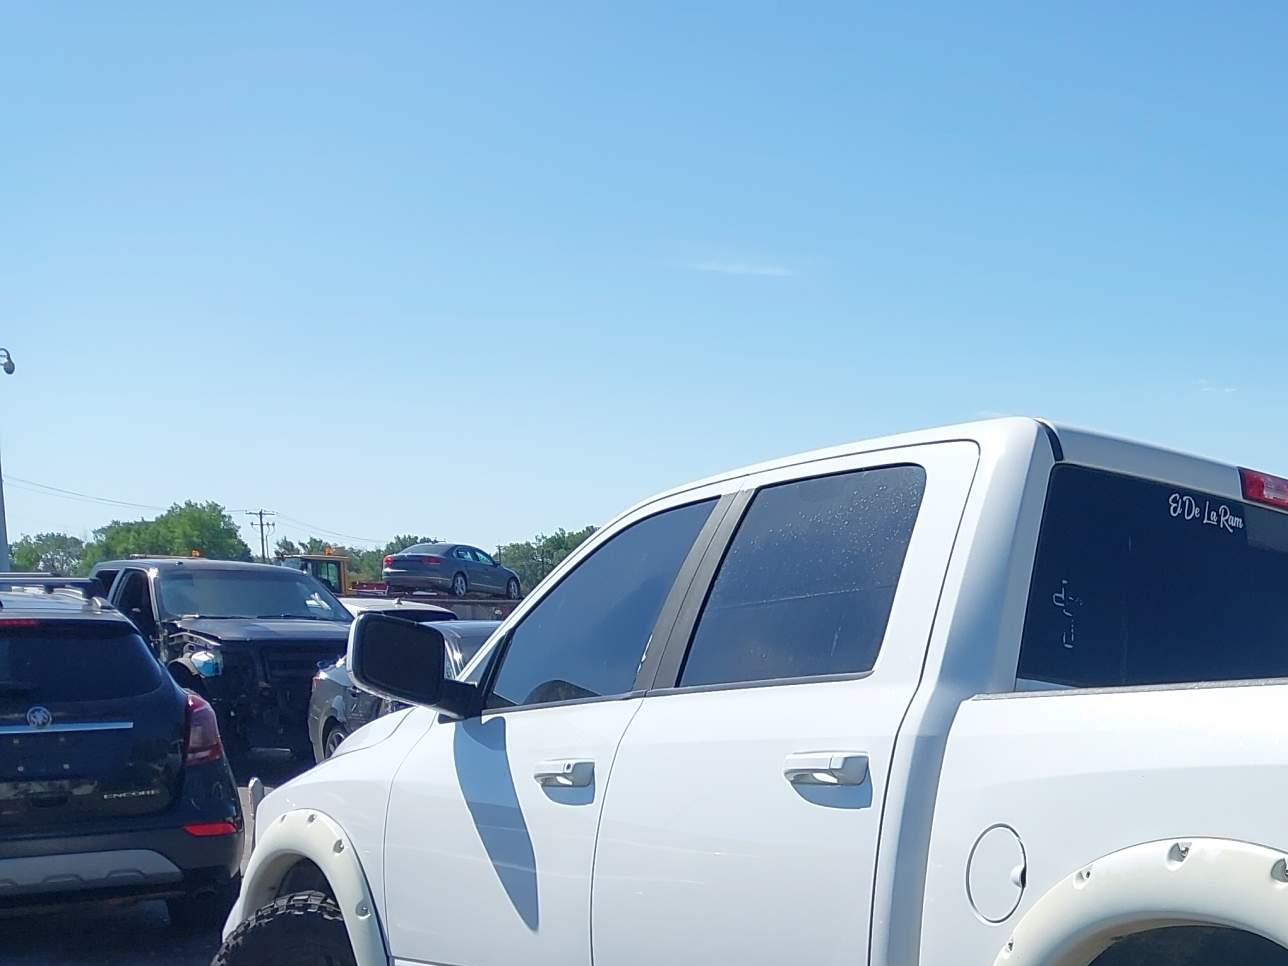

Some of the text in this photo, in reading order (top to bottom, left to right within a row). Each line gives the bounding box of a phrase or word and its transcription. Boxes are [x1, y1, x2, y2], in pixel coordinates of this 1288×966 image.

[1168, 493, 1244, 533] El De La Ram
